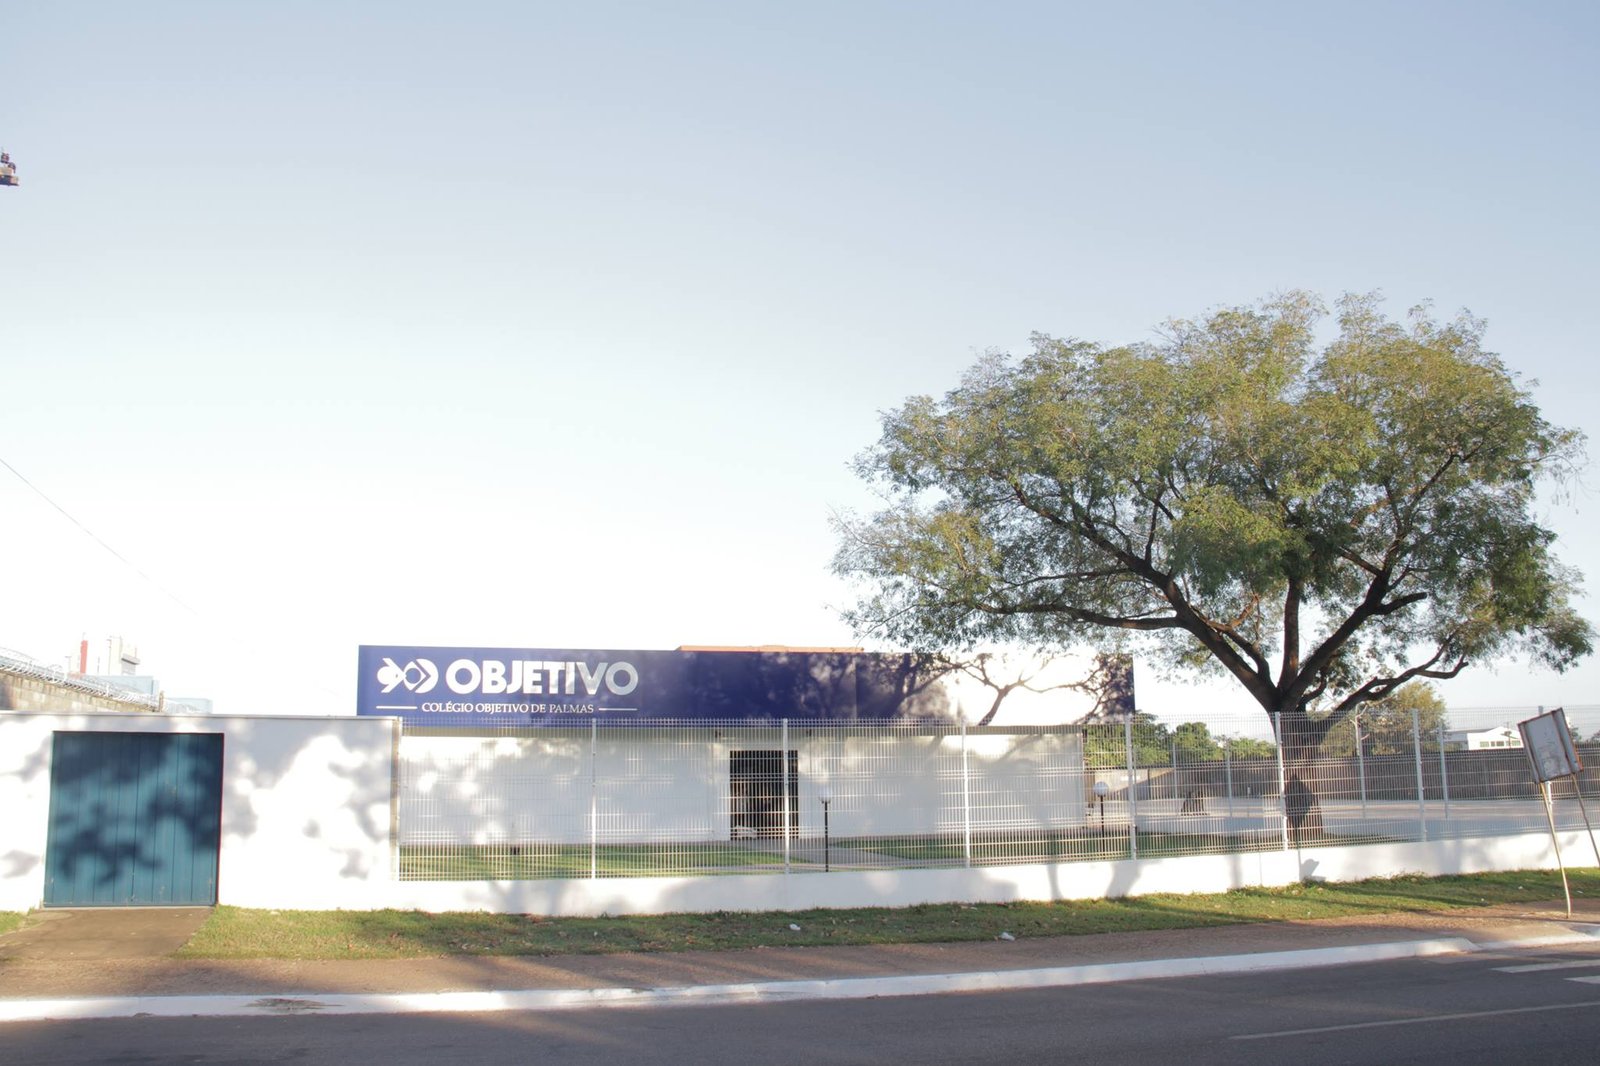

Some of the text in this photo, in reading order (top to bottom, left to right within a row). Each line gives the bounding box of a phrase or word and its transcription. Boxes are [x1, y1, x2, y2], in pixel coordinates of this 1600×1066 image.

[445, 658, 639, 696] OBJETIVO
[421, 701, 594, 714] COLÉGIO OBJETIVO DE PALMAS
